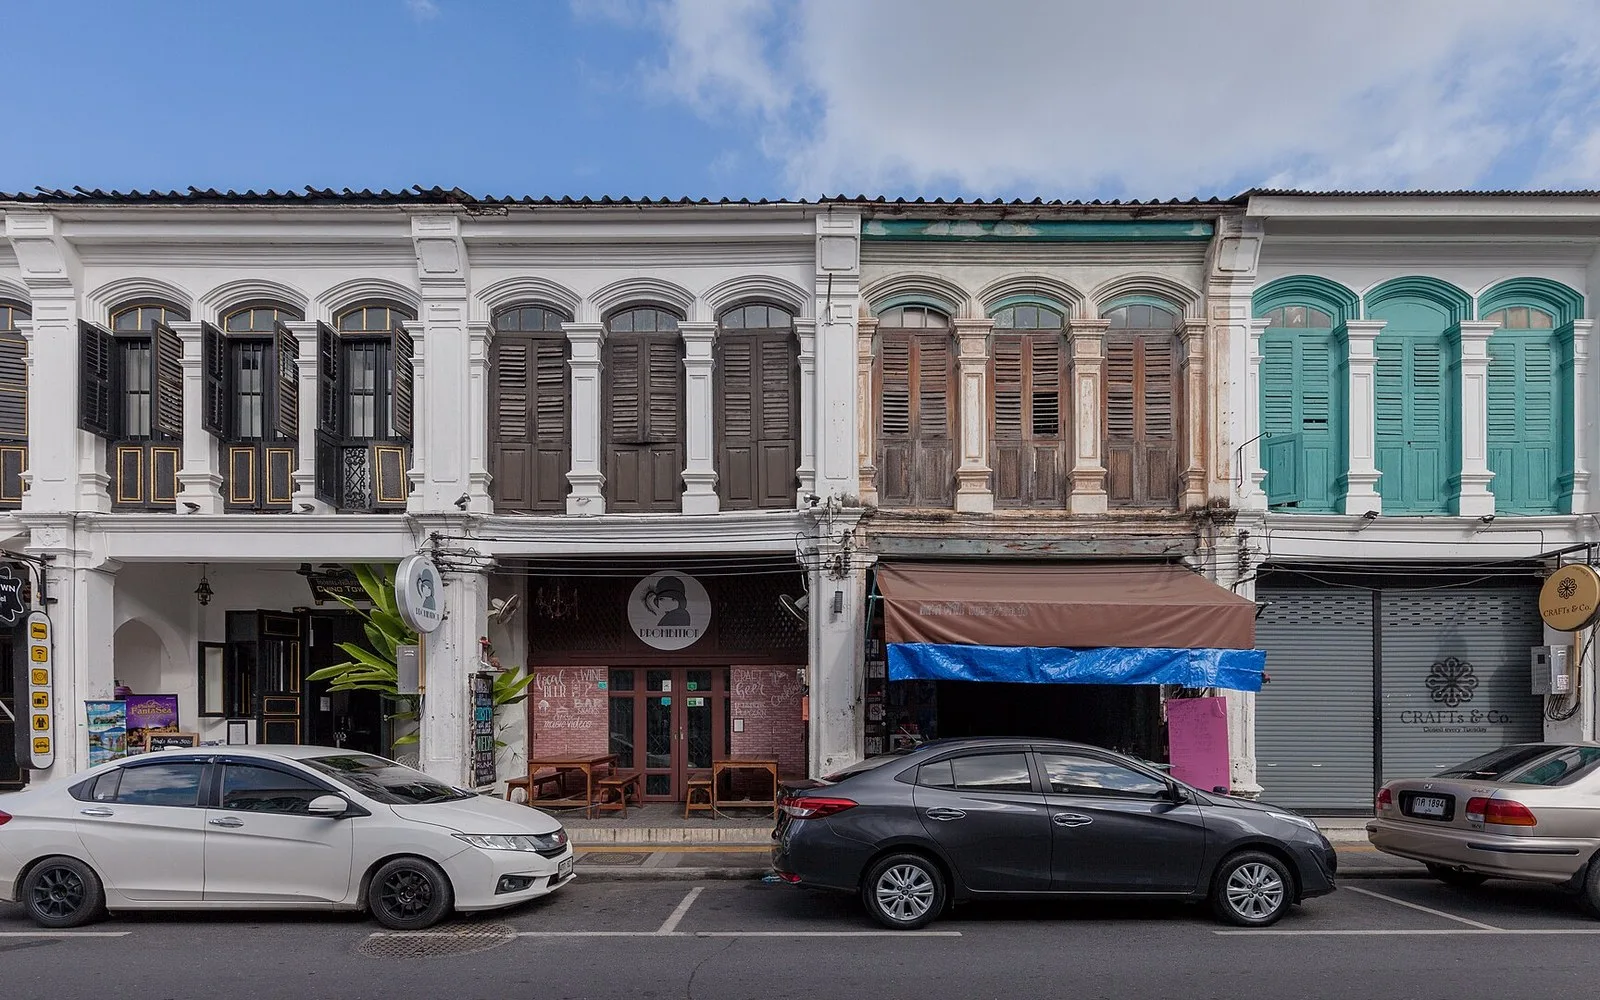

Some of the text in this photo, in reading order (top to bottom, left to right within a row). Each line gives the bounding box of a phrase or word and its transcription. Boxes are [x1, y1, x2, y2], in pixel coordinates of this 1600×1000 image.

[1571, 604, 1579, 612] &
[1579, 603, 1592, 612] Co.
[580, 669, 604, 681] WINE
[1400, 709, 1513, 724] CRAFTs & Co.
[1428, 799, 1444, 808] 1894
